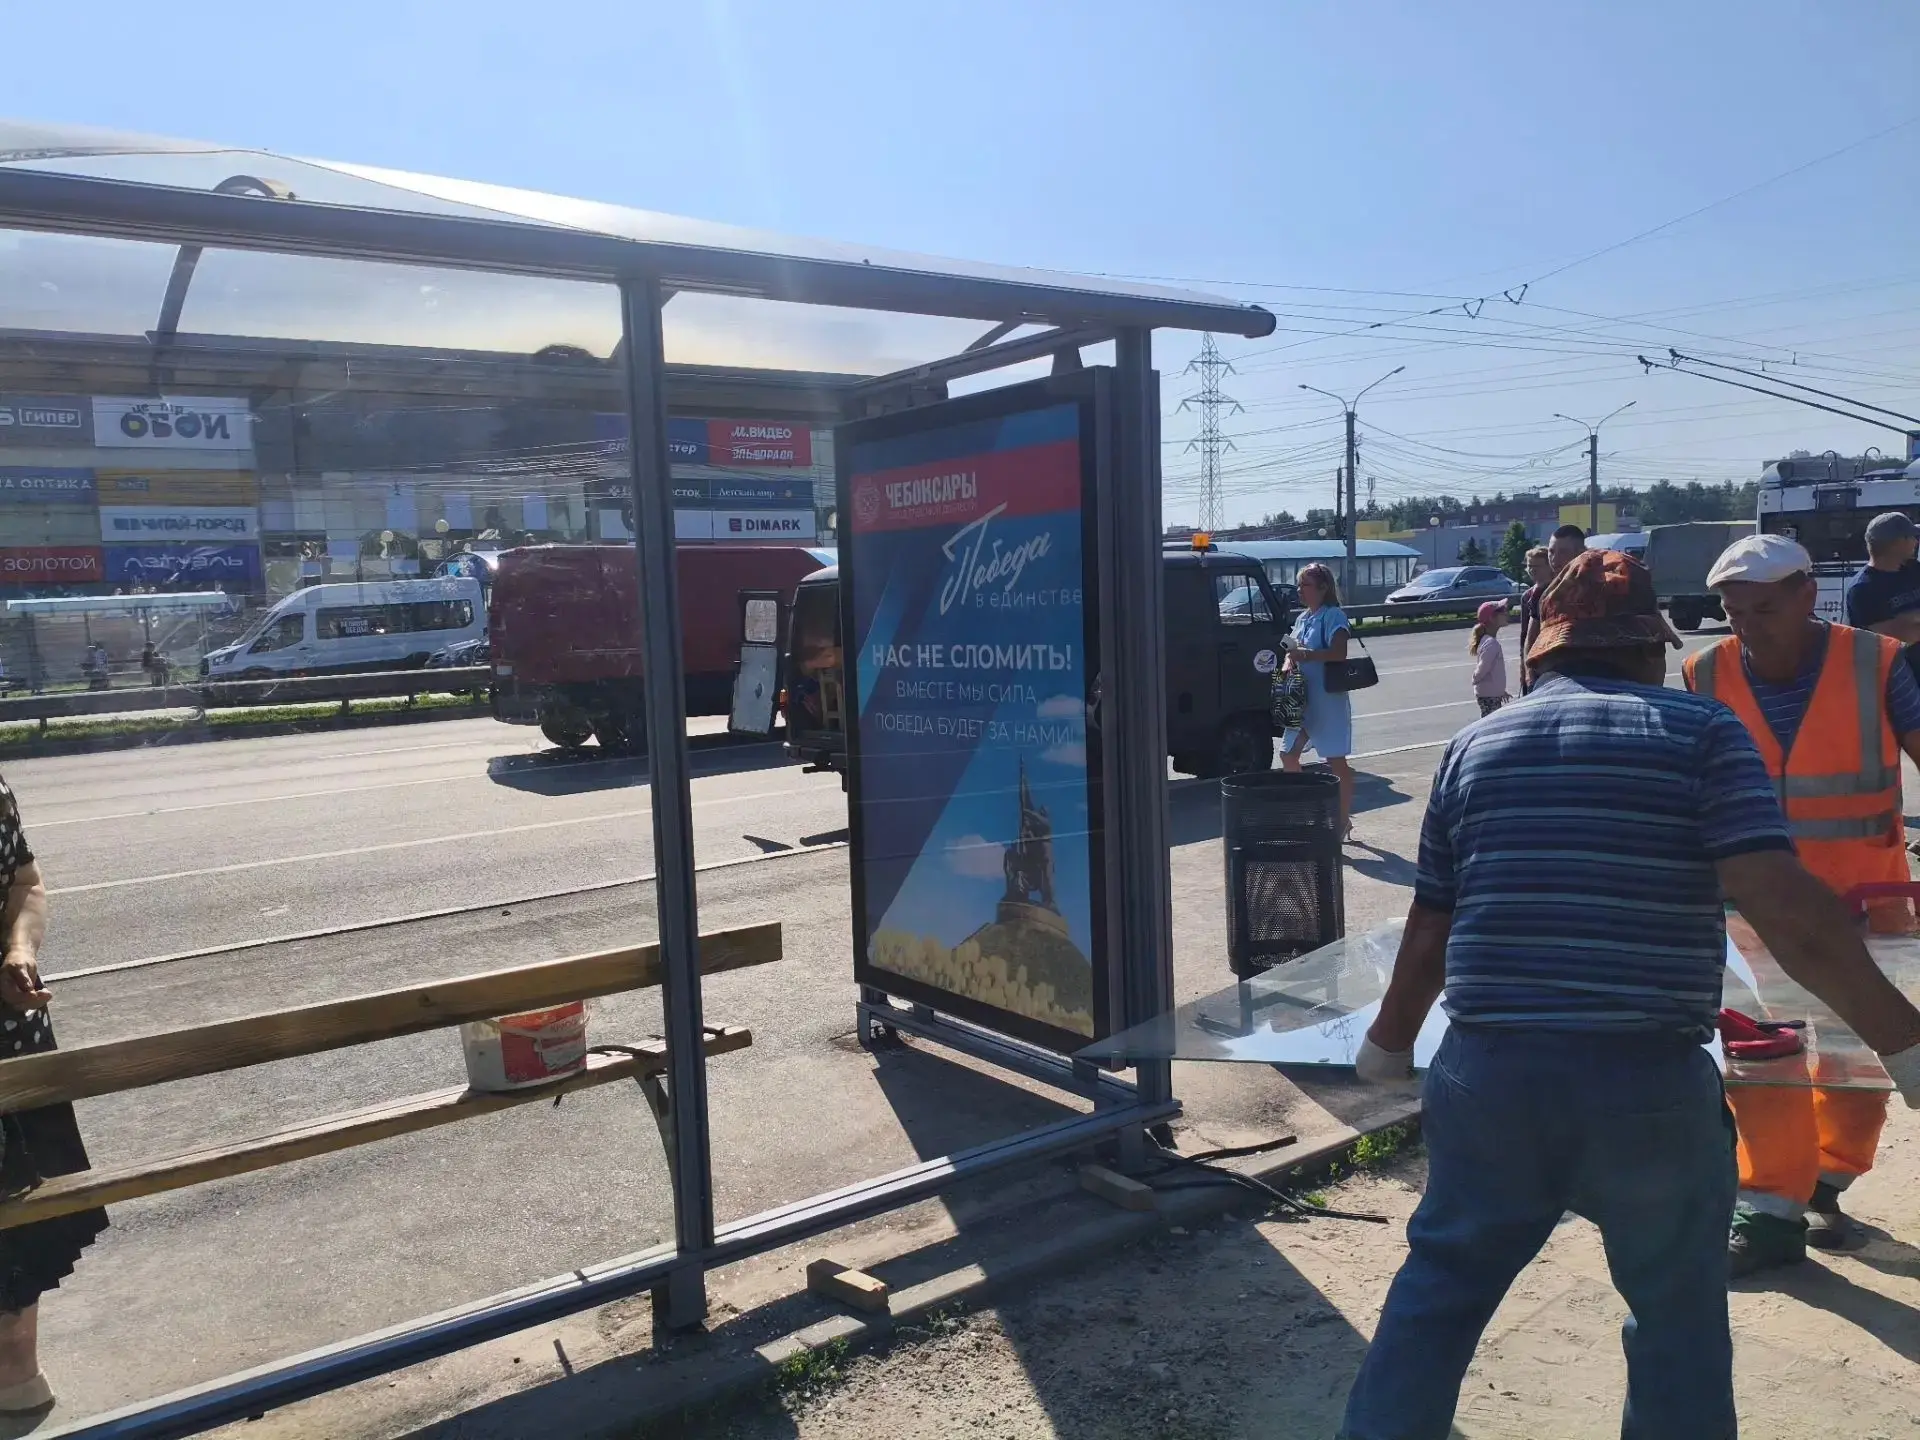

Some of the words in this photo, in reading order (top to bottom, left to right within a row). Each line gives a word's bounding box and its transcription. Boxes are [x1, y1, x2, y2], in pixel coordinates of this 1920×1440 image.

[24, 411, 76, 424] ГИПЕР
[120, 411, 231, 439] ОБОИ
[731, 426, 793, 440] М.ВИДЕО
[20, 478, 92, 489] ОПТИКА
[885, 471, 977, 509] ЧЕБОКСАРЫ
[745, 518, 801, 531] DIMARK
[4, 554, 97, 571] ЗОЛОТОЙ
[940, 501, 1052, 616] Победа
[871, 644, 912, 668] НАС
[917, 644, 945, 669] НЕ
[950, 644, 1073, 672] СЛОМИТЬ!
[896, 680, 954, 700] ВМЕСТЕ
[959, 683, 984, 701] МЫ
[875, 712, 934, 736] ПОБЕДА
[937, 717, 985, 741] БУДЕТ
[988, 720, 1010, 742] ЗА
